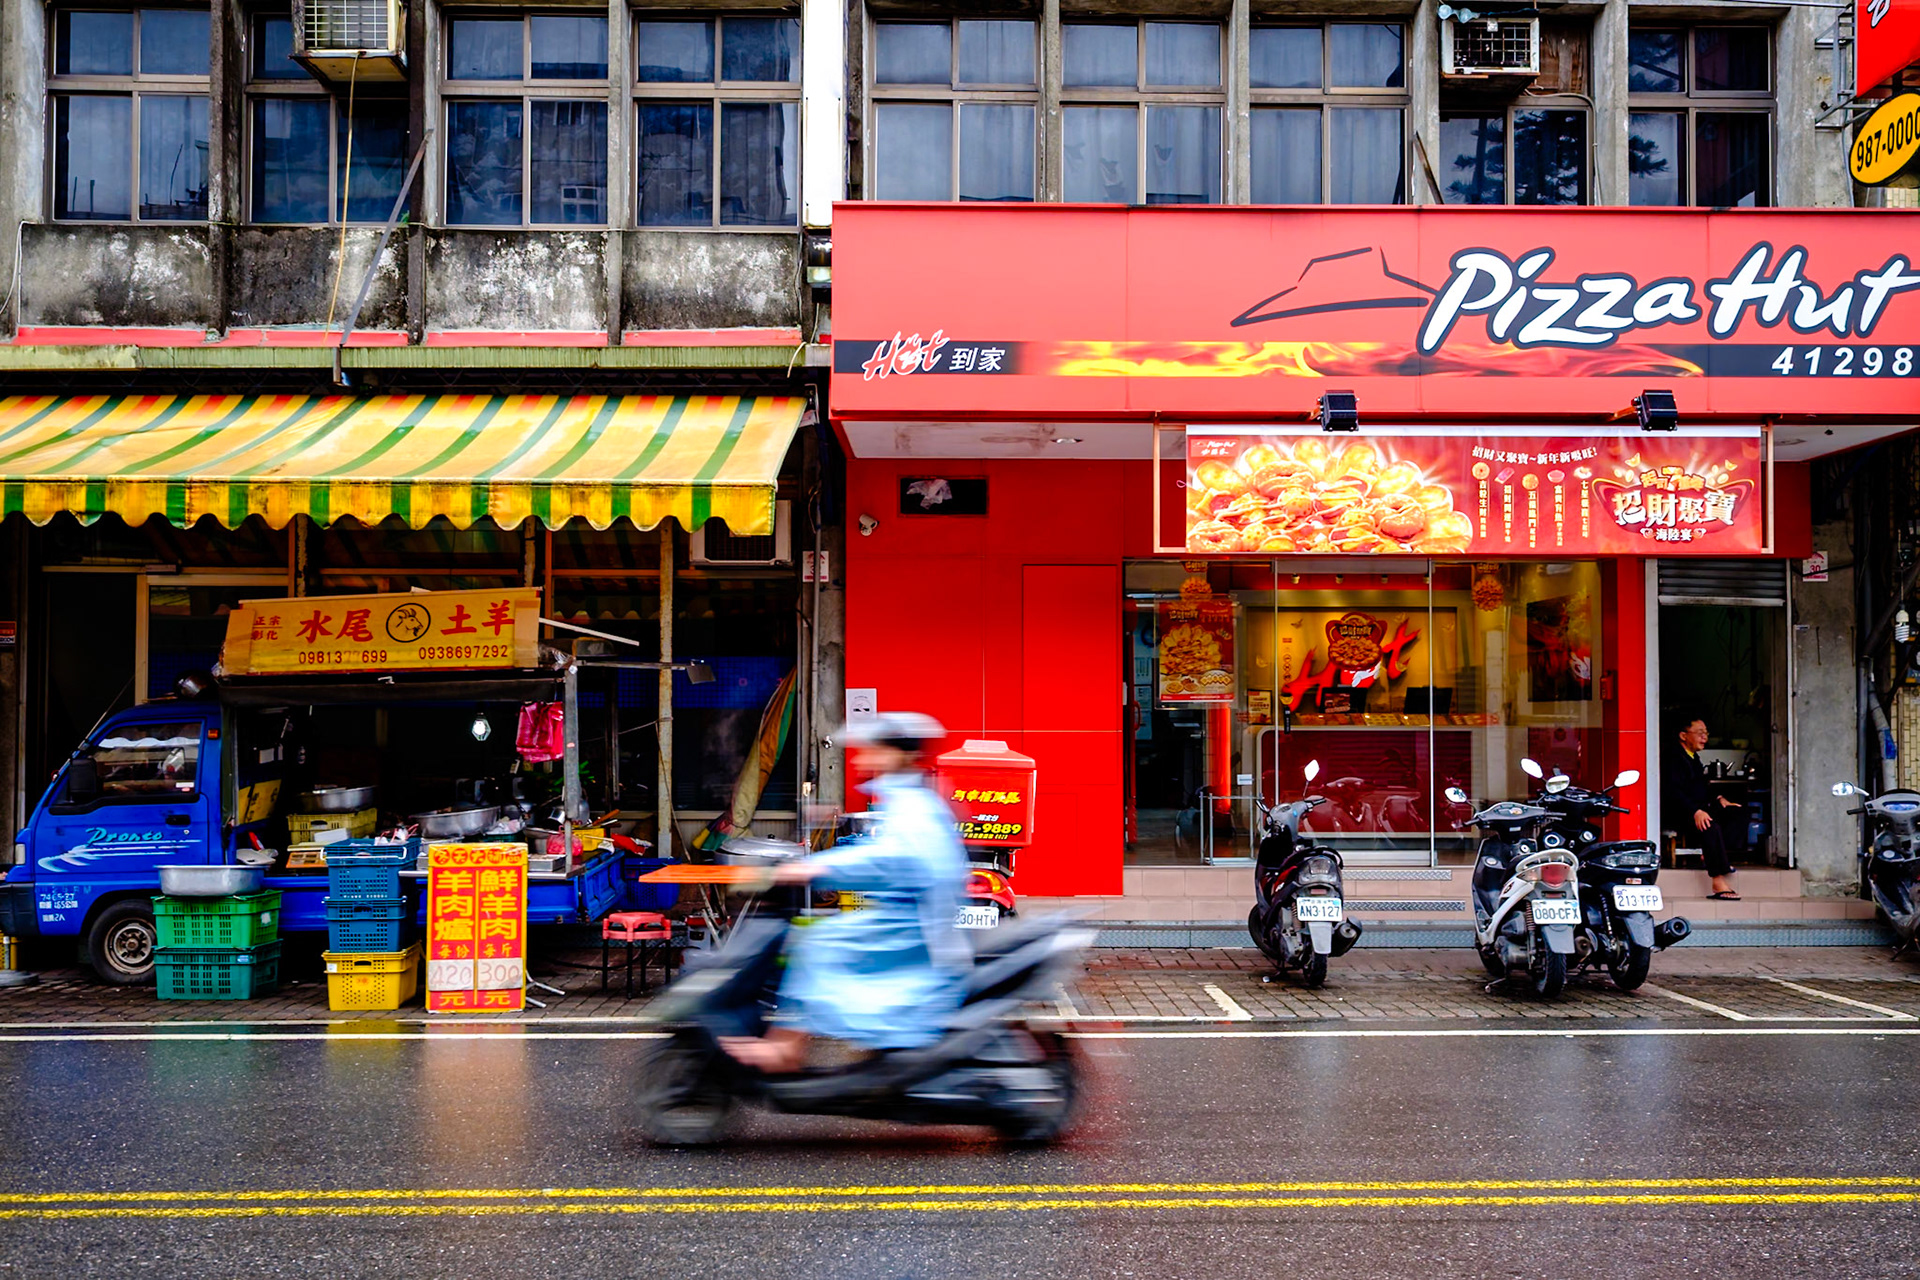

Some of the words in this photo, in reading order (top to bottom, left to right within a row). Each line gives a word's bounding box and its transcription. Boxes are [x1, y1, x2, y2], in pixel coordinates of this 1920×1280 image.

[1417, 248, 1700, 355] Pizza
[1708, 244, 1920, 338] Hut
[862, 329, 950, 381] Hot
[949, 347, 1006, 372] 到家
[1772, 346, 1914, 376] 41298
[1611, 490, 1738, 527] 招財聚寶
[1655, 528, 1693, 541] 海陸宴
[252, 615, 281, 626] 正宗
[296, 608, 374, 643] 水尾
[440, 599, 516, 636] 土羊
[419, 645, 508, 660] 0938697292
[85, 827, 163, 844] Pronto
[434, 870, 474, 941] 羊肉爐
[480, 869, 518, 941] 鮮羊肉
[438, 943, 470, 958] 每份
[483, 942, 512, 958] 每斤
[480, 962, 521, 984] 300
[438, 991, 466, 1007] 元
[484, 991, 511, 1006] 元
